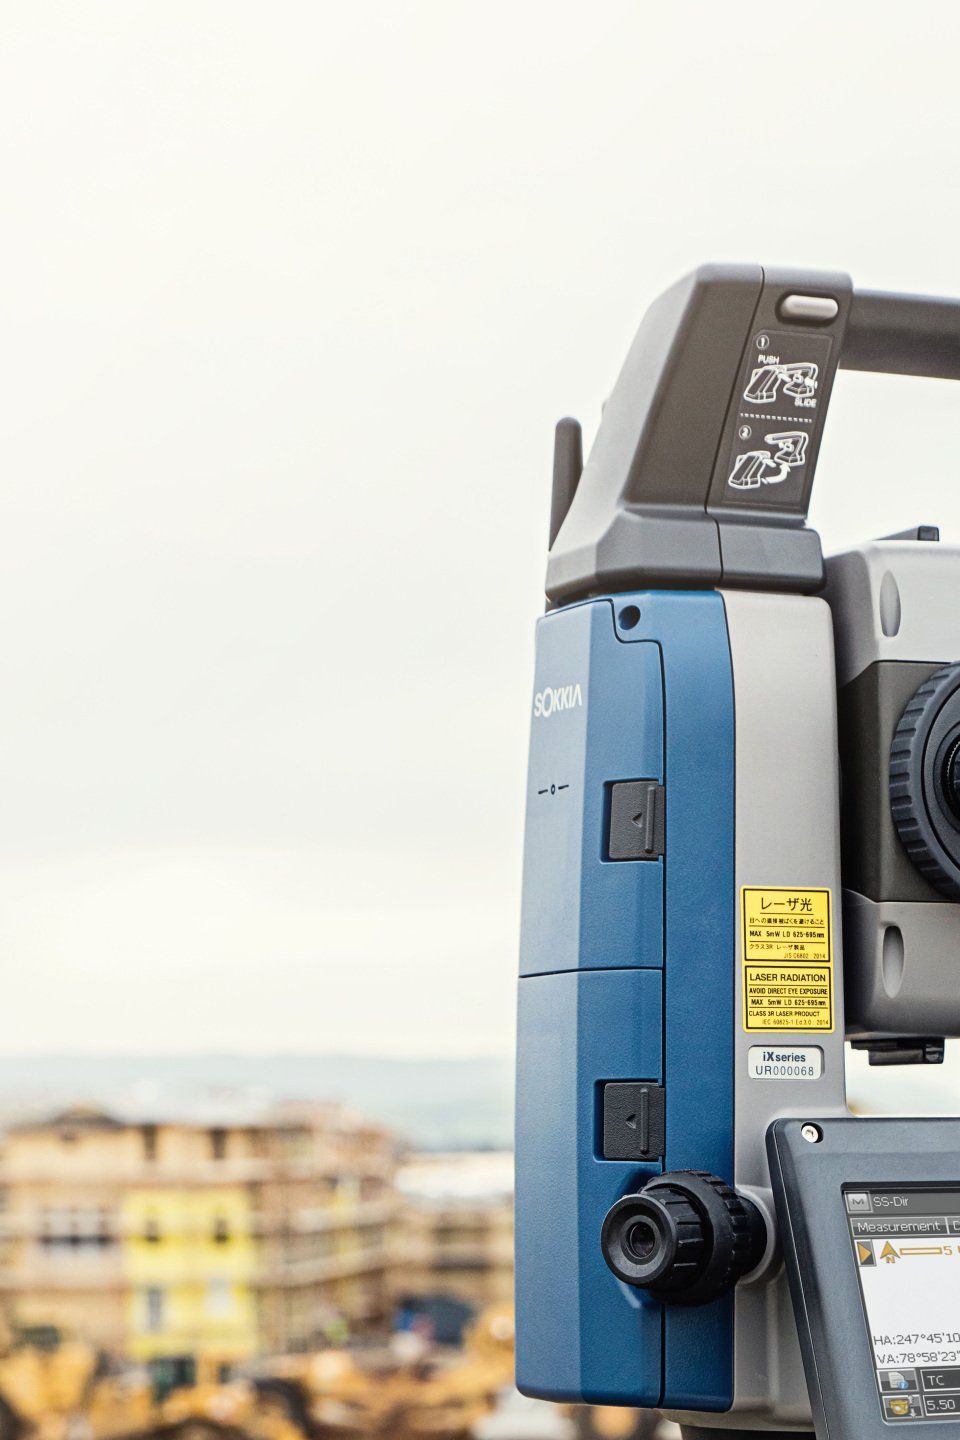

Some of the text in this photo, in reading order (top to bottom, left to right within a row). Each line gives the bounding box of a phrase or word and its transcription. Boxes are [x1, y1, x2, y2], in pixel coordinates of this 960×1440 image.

[757, 354, 780, 365] PUSH
[794, 398, 818, 409] SLIDE
[534, 683, 583, 718] SOKKIA
[761, 897, 812, 912] レーザ光
[749, 973, 826, 982] LASER RADIATION
[755, 1065, 814, 1076] UR000068
[873, 1196, 909, 1207] SS-Dir
[857, 1220, 941, 1233] Measurement
[943, 1245, 953, 1256] 5
[926, 1375, 945, 1386] TC
[926, 1399, 956, 1411] 5.50
